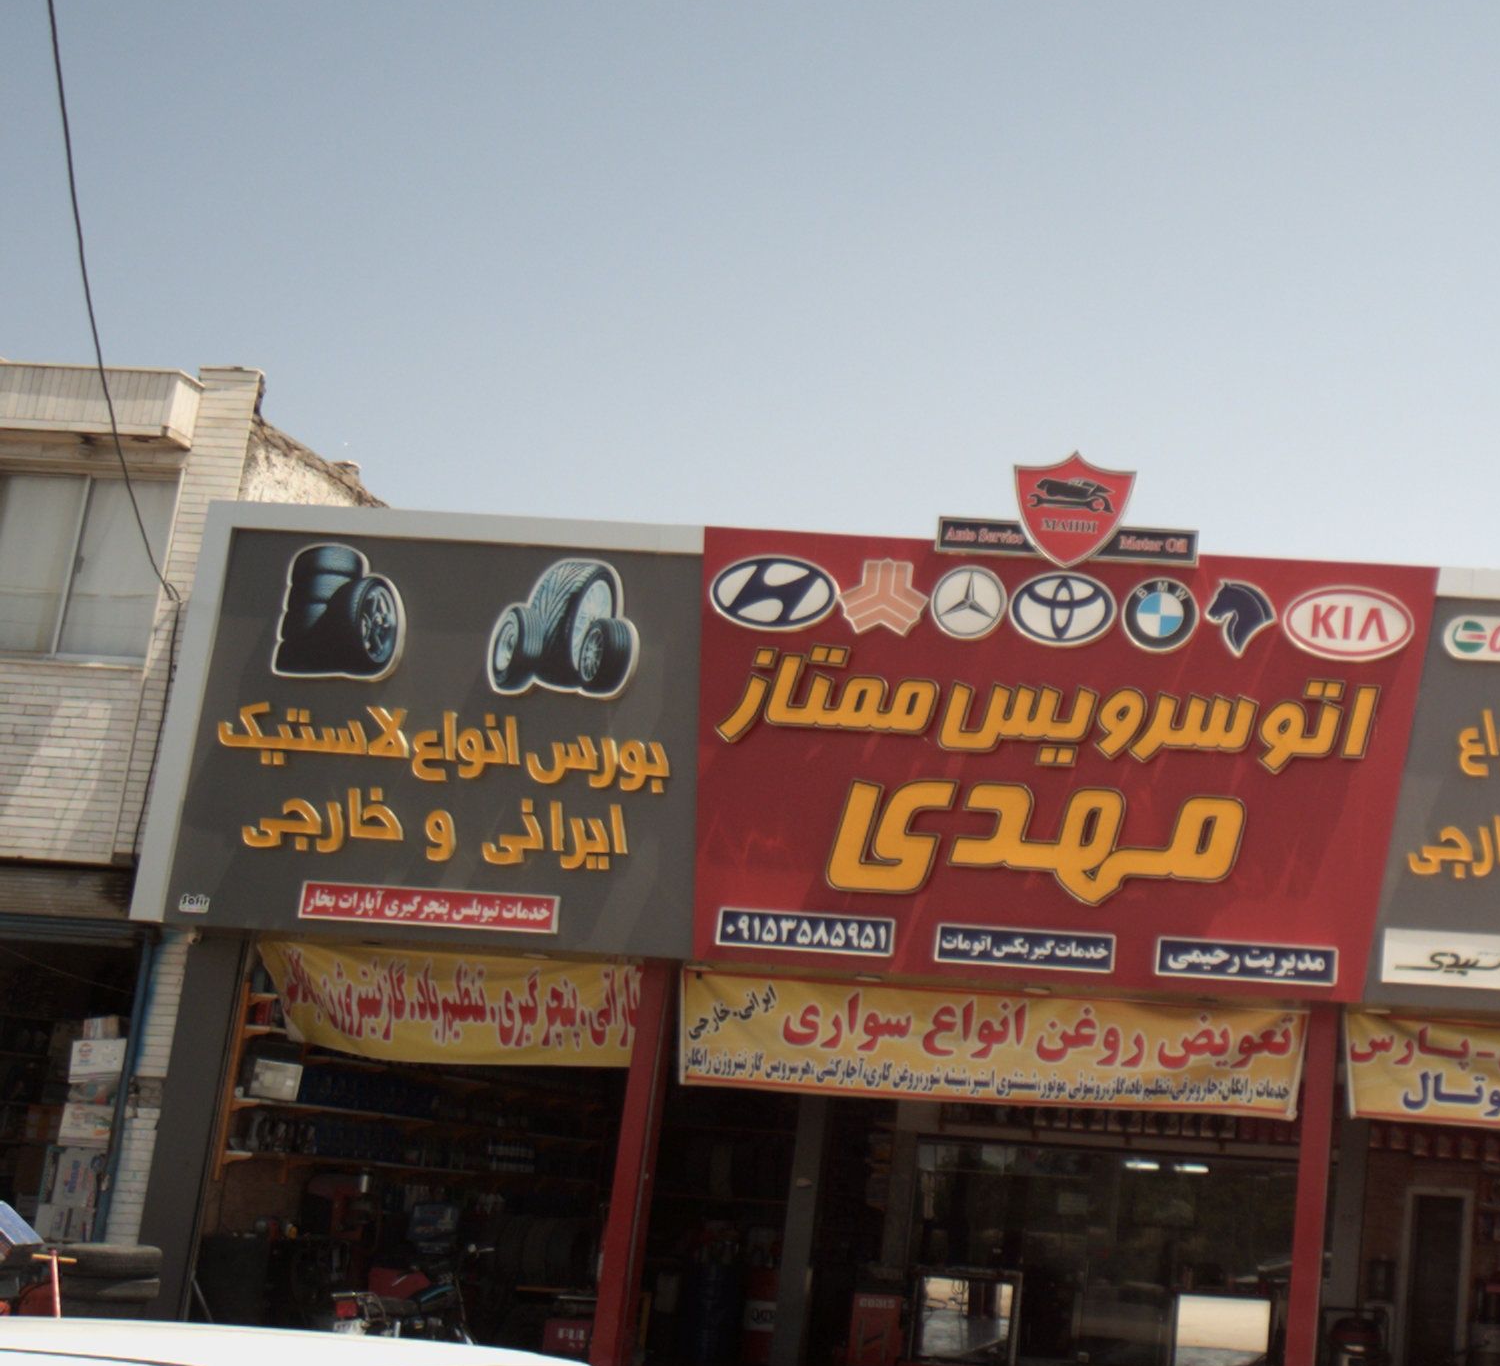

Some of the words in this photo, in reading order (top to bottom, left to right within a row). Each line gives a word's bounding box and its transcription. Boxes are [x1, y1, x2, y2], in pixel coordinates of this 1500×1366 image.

[944, 526, 976, 543] Auto
[977, 527, 1026, 547] Service
[1041, 518, 1100, 535] MAHDI
[1118, 535, 1165, 553] Motor
[1165, 536, 1189, 554] Oil
[1136, 581, 1190, 602] BMW
[1310, 603, 1390, 644] KIA
[715, 644, 940, 743] ممتاز
[218, 701, 411, 766] لاستیک
[411, 710, 520, 782] انواع
[526, 735, 670, 794] بورس
[241, 787, 405, 853] خارجی
[425, 809, 457, 862] و
[482, 798, 629, 871] ایرانی
[825, 778, 1247, 905] مهدی
[305, 888, 337, 913] بخار
[337, 889, 386, 916] آپارات
[451, 898, 501, 923] تیوبلس
[501, 901, 552, 922] خدمات
[725, 914, 888, 950] ۰۹۱۵۳۵۸۵۹۵۱
[941, 933, 991, 956] اتومات
[1055, 937, 1110, 960] خدمات
[1166, 946, 1241, 974] رحیمی
[1243, 948, 1326, 977] مدیریت
[782, 990, 912, 1052] سواری
[922, 998, 1029, 1061] انواع
[1036, 1006, 1147, 1068] روغن
[1157, 1012, 1295, 1069] تعویض
[1349, 1026, 1471, 1072] پارس
